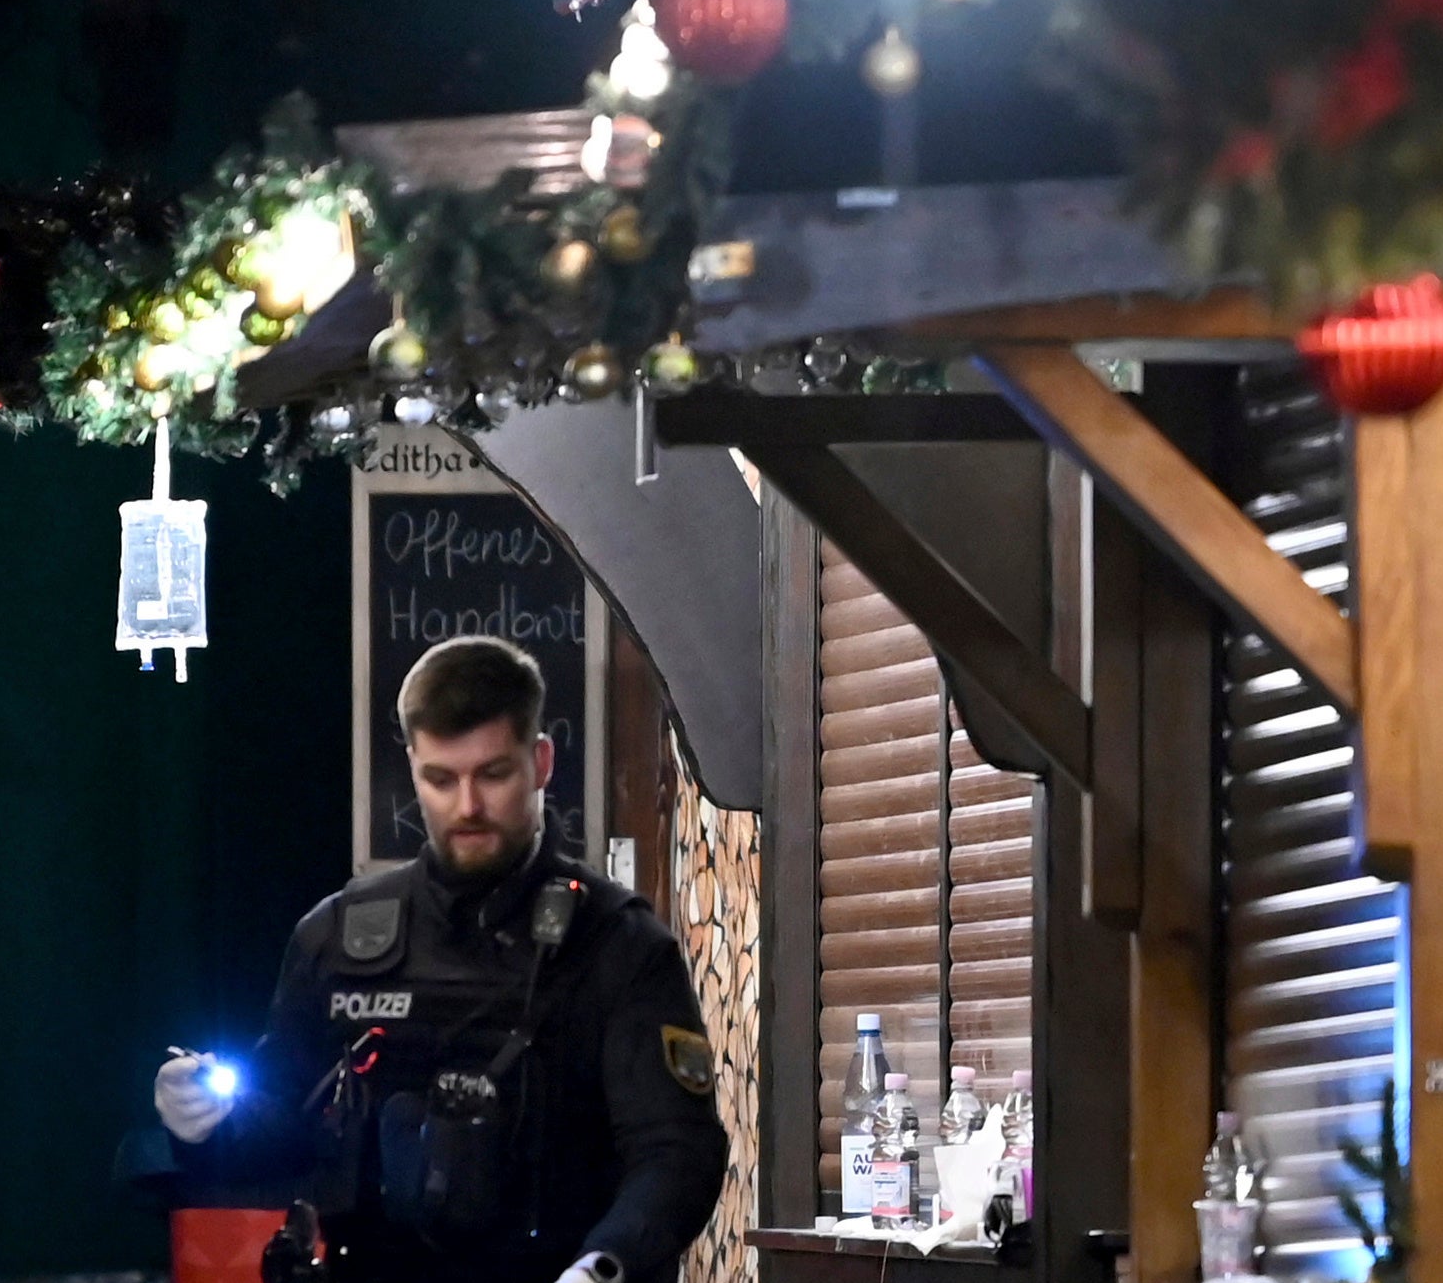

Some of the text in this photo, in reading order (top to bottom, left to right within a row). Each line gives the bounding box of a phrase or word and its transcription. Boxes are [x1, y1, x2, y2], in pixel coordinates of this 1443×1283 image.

[385, 508, 552, 579] Offenes
[388, 582, 585, 645] Handbrot
[329, 991, 413, 1021] POLIZEI
